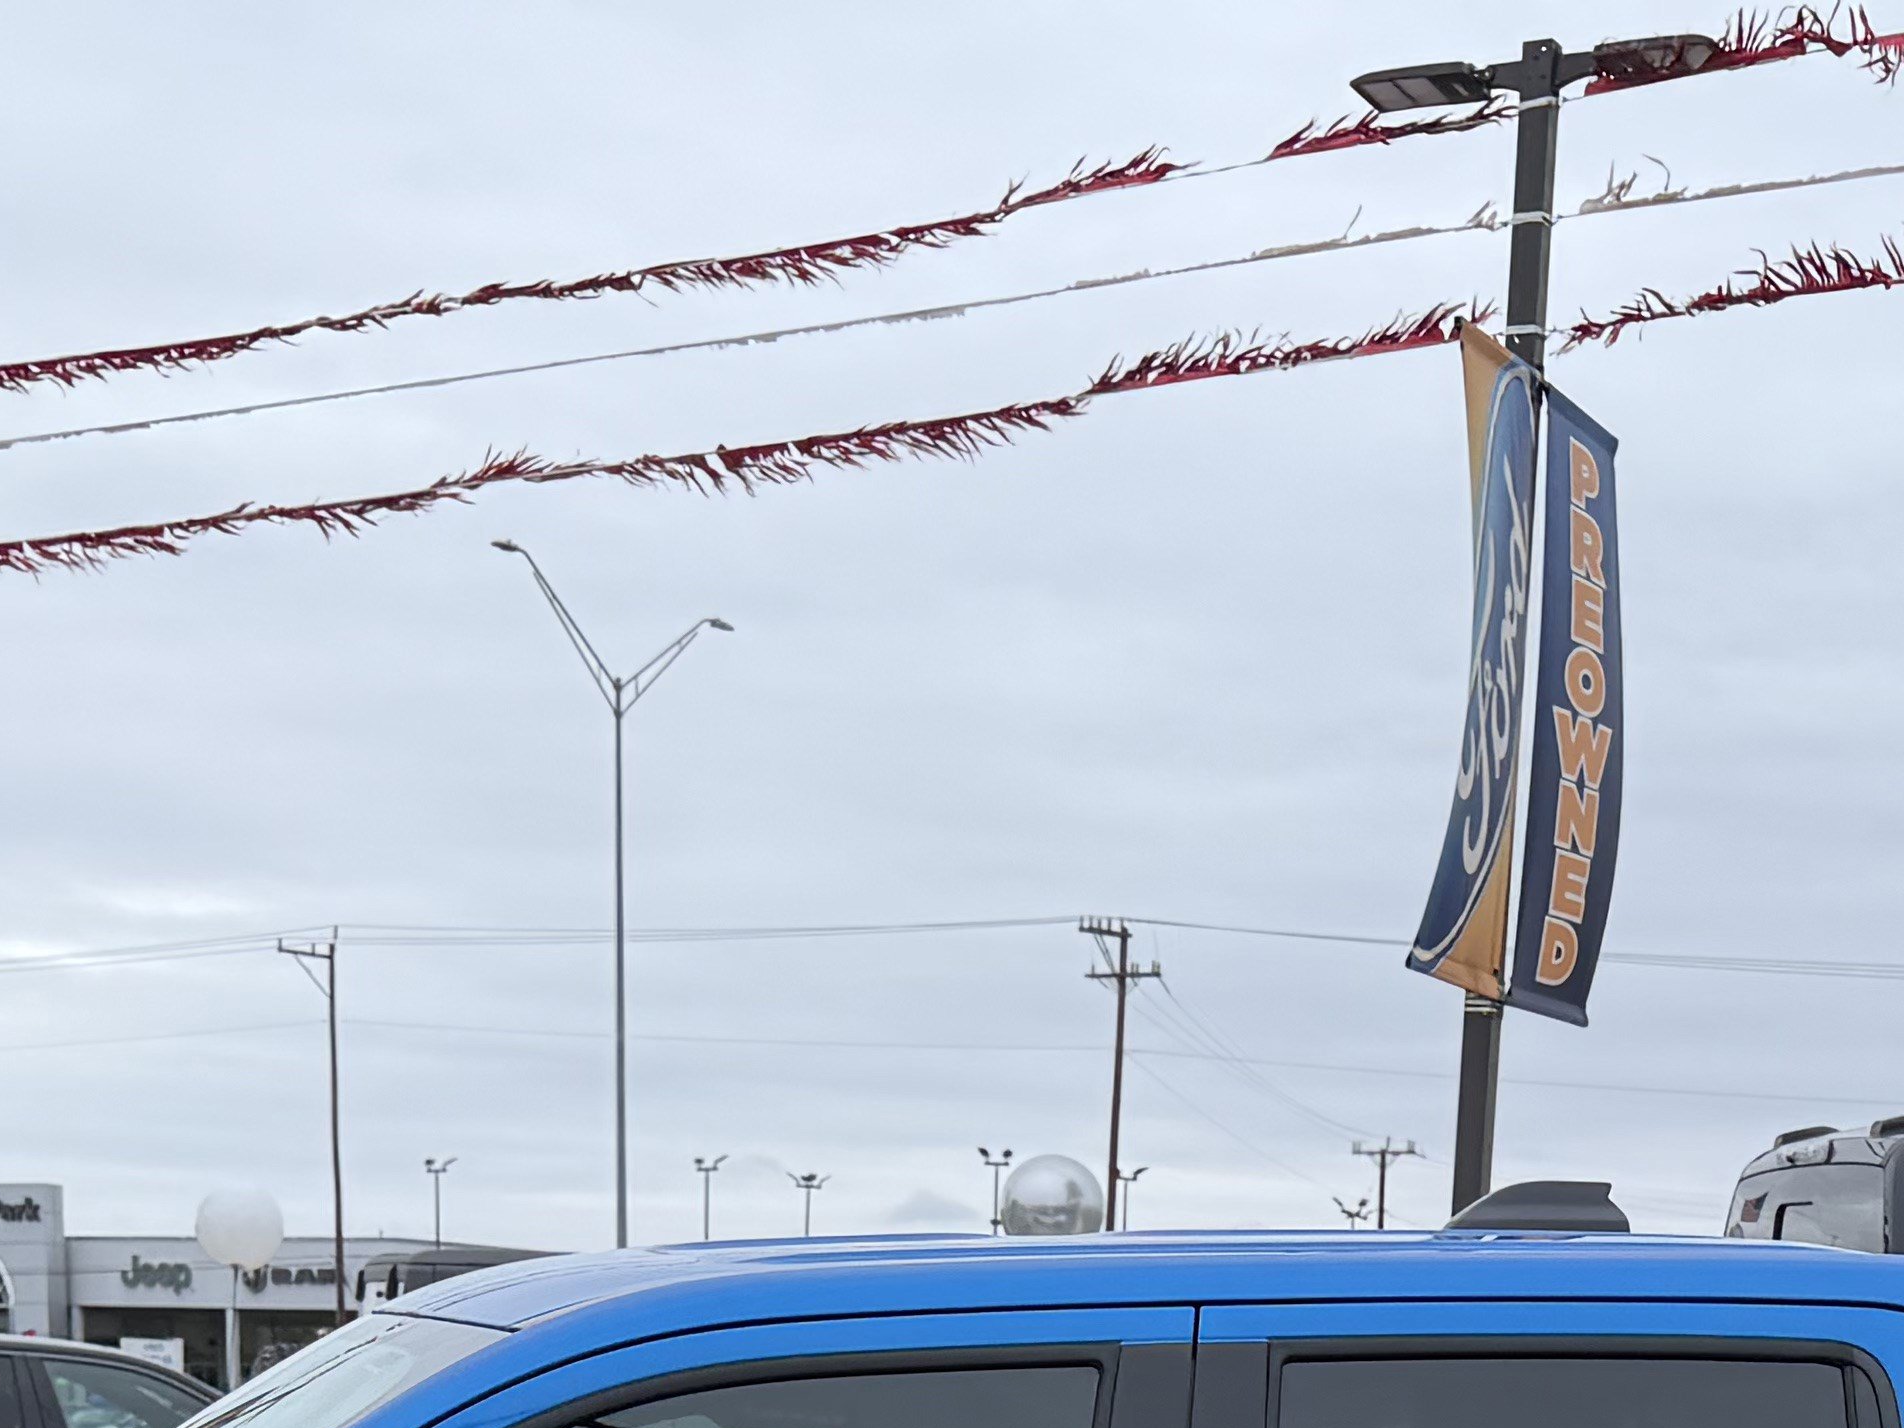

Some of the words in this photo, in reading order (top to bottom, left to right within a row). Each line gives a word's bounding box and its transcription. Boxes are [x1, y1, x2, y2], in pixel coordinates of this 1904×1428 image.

[1456, 455, 1530, 876] Ford
[1536, 436, 1614, 987] PREOWNED
[120, 1255, 193, 1296] Jeep
